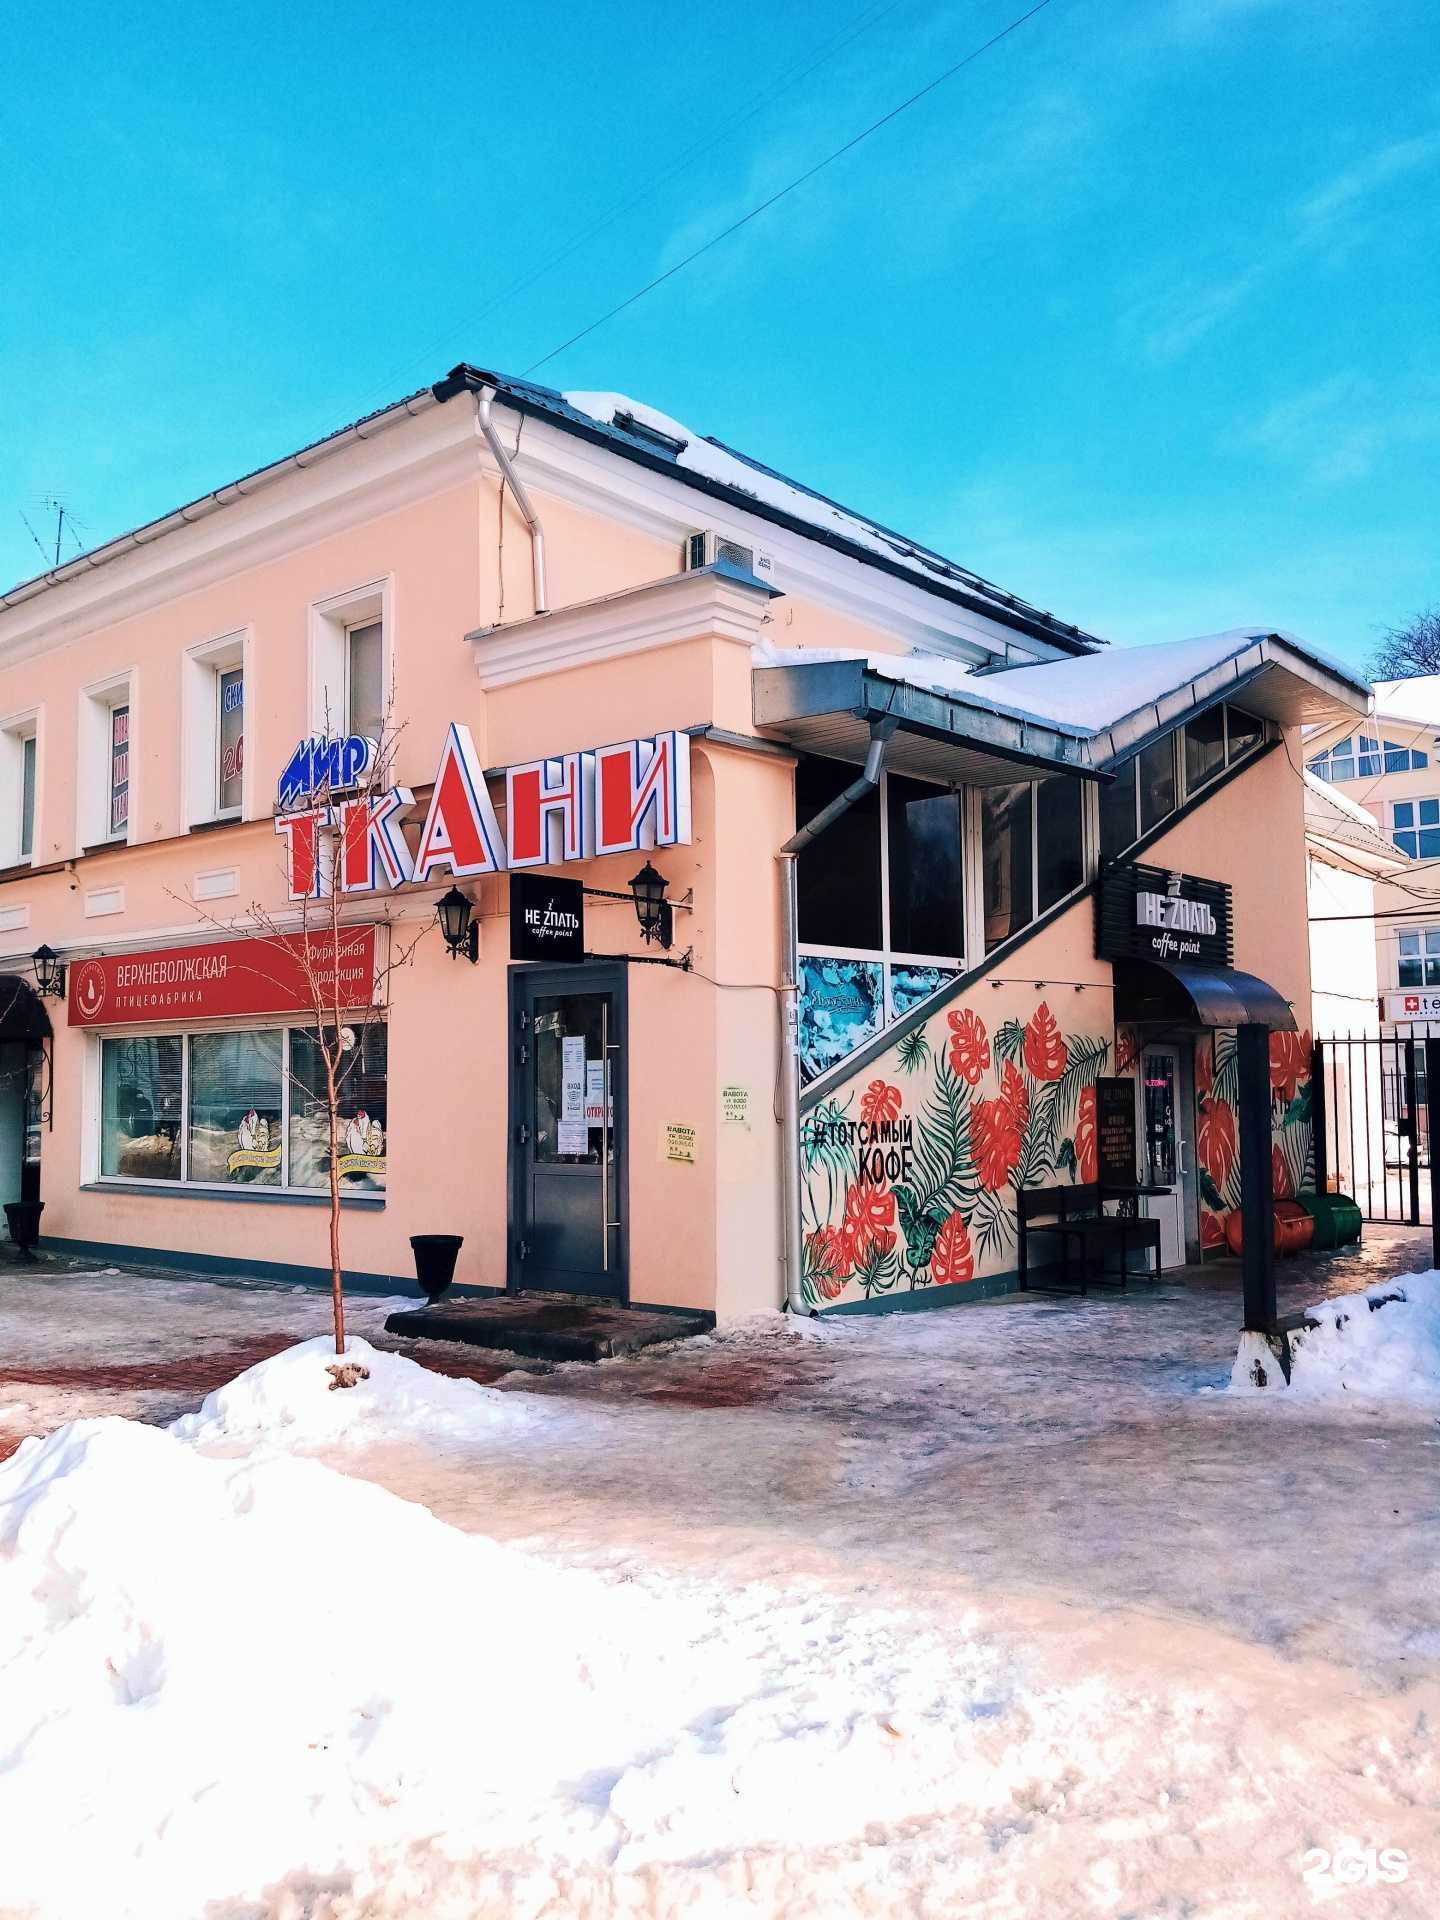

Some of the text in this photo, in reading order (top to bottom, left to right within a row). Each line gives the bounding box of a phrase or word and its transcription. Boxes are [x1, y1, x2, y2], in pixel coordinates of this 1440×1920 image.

[278, 735, 372, 807] МИР
[274, 721, 690, 901] ТКАНИ
[525, 908, 541, 925] НЕ
[1137, 891, 1166, 928] НЕ
[532, 926, 573, 939] coffee point
[1152, 932, 1201, 959] coffee point
[117, 955, 228, 988] ВЕРХНЕВОЛЖСКАЯ
[312, 967, 364, 985] родкция
[116, 991, 202, 1008] ПТИЦЕФАБРИКА
[586, 1106, 613, 1119] ОТКРТО
[812, 1115, 913, 1149] #ТОТСАМЫЙ
[859, 1146, 913, 1186] КОФЕ
